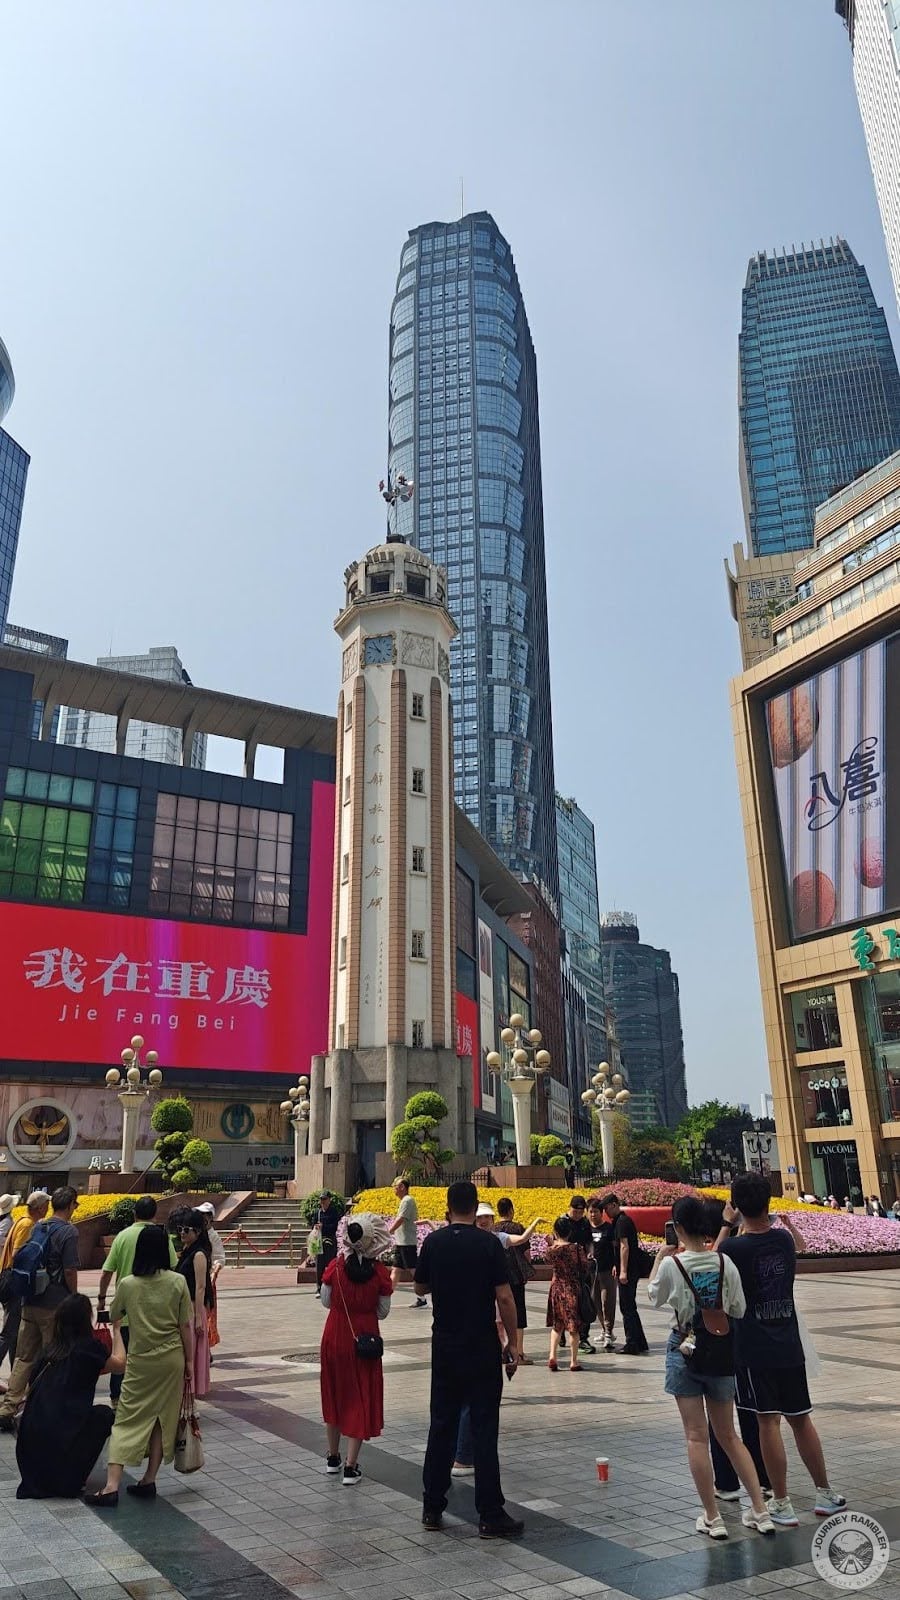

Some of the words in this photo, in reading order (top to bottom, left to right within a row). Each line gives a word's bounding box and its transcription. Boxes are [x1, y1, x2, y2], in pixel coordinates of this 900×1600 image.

[23, 947, 272, 1008] 我在重慶
[59, 1005, 98, 1022] Jie
[116, 1009, 179, 1029] Fang
[197, 1014, 235, 1030] Bei
[88, 1154, 122, 1170] 周六
[246, 1155, 269, 1168] ABC
[755, 1299, 793, 1321] NIKE
